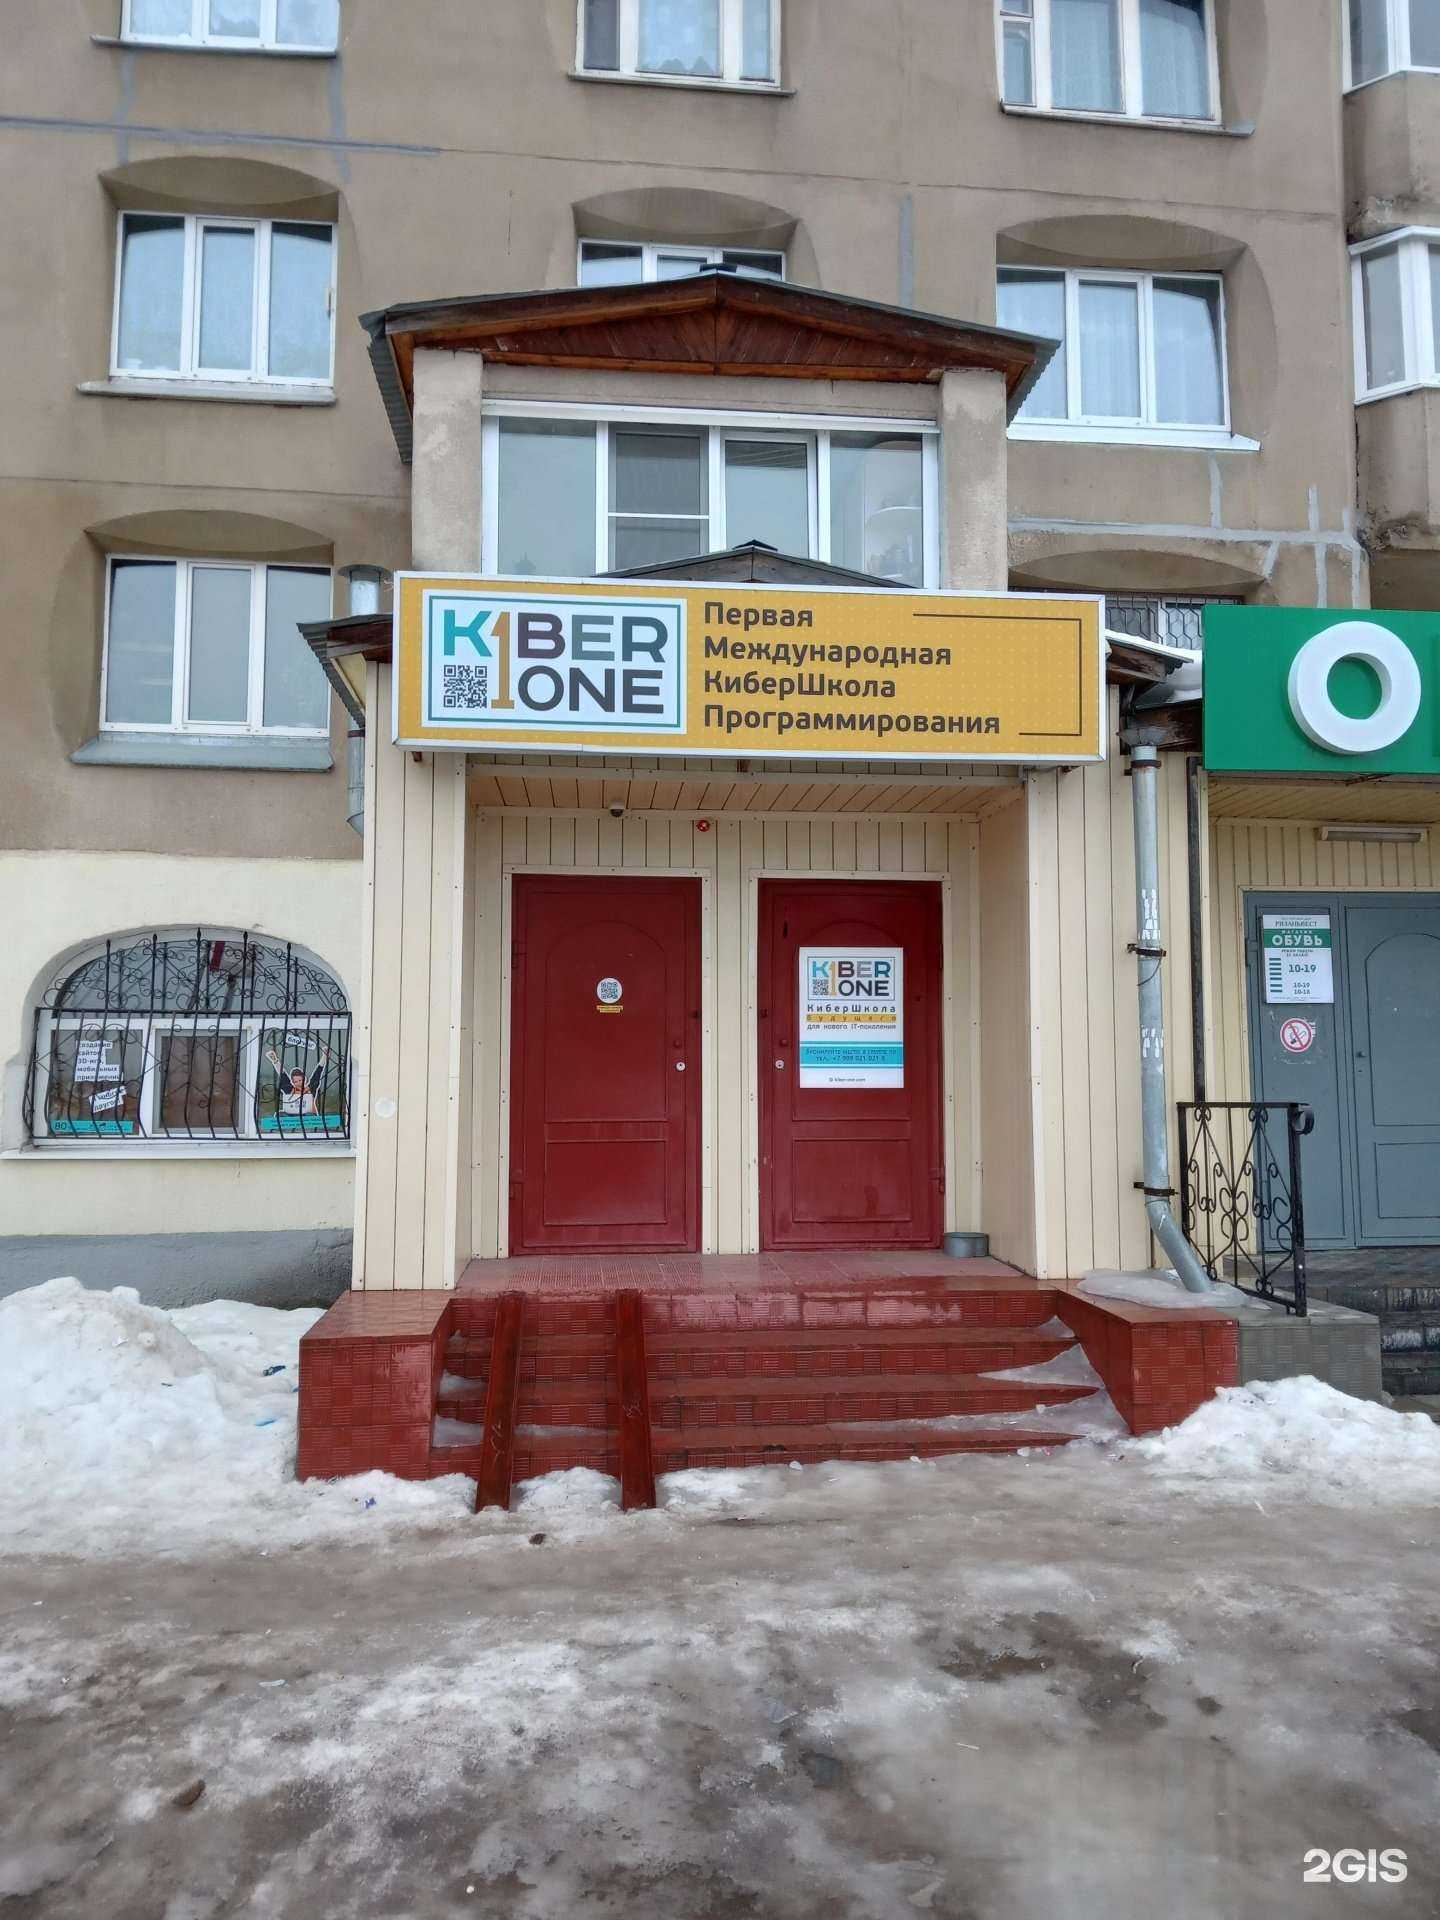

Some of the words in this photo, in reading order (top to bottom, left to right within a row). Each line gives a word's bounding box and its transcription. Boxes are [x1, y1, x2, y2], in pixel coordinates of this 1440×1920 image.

[704, 601, 813, 631] Первая
[704, 635, 951, 668] Международная
[517, 665, 665, 714] ONE
[704, 670, 896, 700] КиберШкола
[704, 704, 1000, 737] Программирования
[1271, 934, 1323, 946] ОБУВЬ
[1288, 964, 1317, 973] 10-19
[838, 979, 890, 997] ONE
